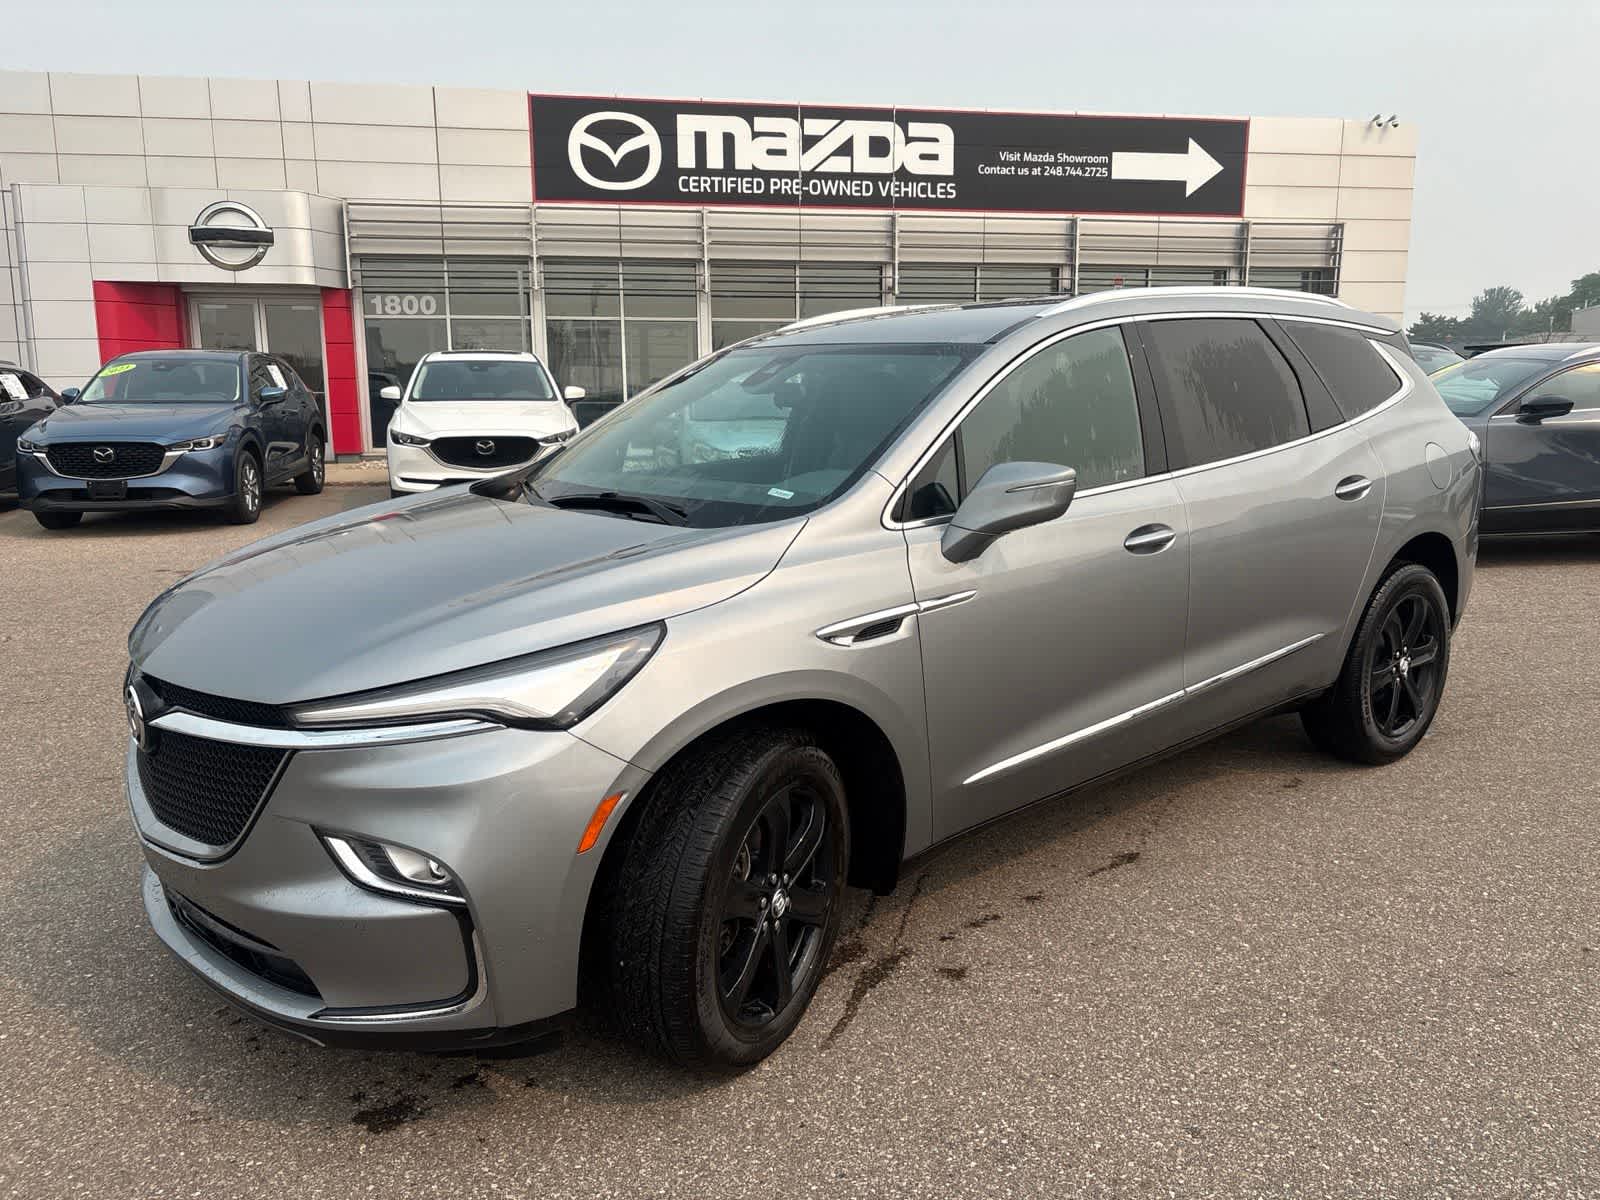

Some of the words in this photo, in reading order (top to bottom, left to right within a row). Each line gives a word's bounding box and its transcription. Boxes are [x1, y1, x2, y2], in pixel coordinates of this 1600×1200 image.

[1000, 151, 1021, 161] Visit
[1023, 151, 1055, 163] Mazda
[1057, 152, 1109, 164] Showroom
[978, 164, 1016, 175] Contact
[1017, 167, 1030, 176] us
[1031, 166, 1042, 176] at
[1044, 166, 1109, 177] 248.744.2725
[678, 175, 765, 194] CERTIFIED
[769, 178, 873, 197] PRE-OWNED
[878, 180, 956, 199] VEHICLES
[371, 295, 437, 315] 1800
